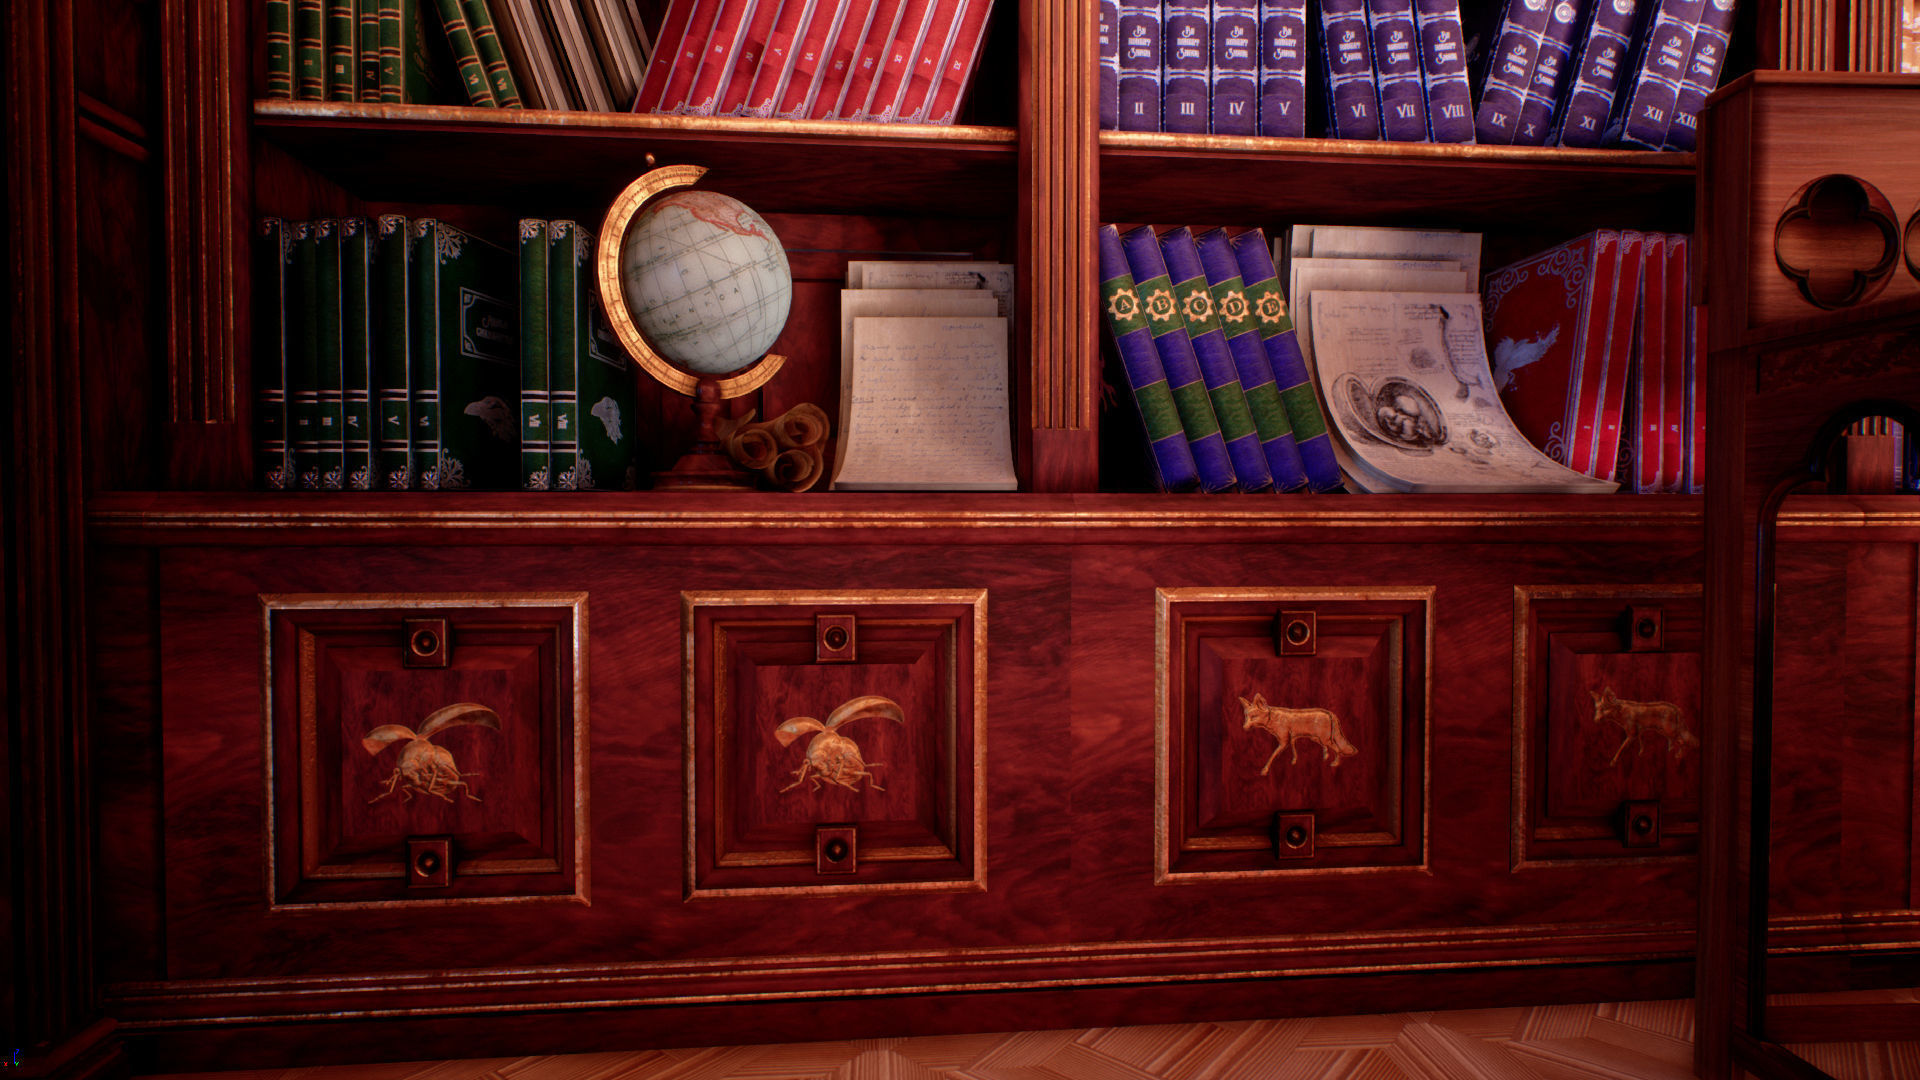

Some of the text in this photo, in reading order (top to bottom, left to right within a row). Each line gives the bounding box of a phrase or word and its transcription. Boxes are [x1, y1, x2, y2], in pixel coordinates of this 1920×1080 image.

[1134, 102, 1144, 115] II
[1180, 102, 1195, 115] III
[1229, 101, 1245, 116] IV
[1279, 101, 1291, 116] V
[1351, 103, 1366, 117] VI
[1396, 103, 1415, 117] VII
[1441, 104, 1464, 118] VIII
[1643, 105, 1664, 123] XII
[1491, 111, 1507, 128] IX
[1580, 115, 1596, 130] XI
[1523, 123, 1536, 138] X
[1120, 299, 1132, 311] A
[1155, 298, 1169, 312] B
[1194, 299, 1206, 312] C
[1229, 300, 1242, 314] D
[1265, 302, 1278, 314] E
